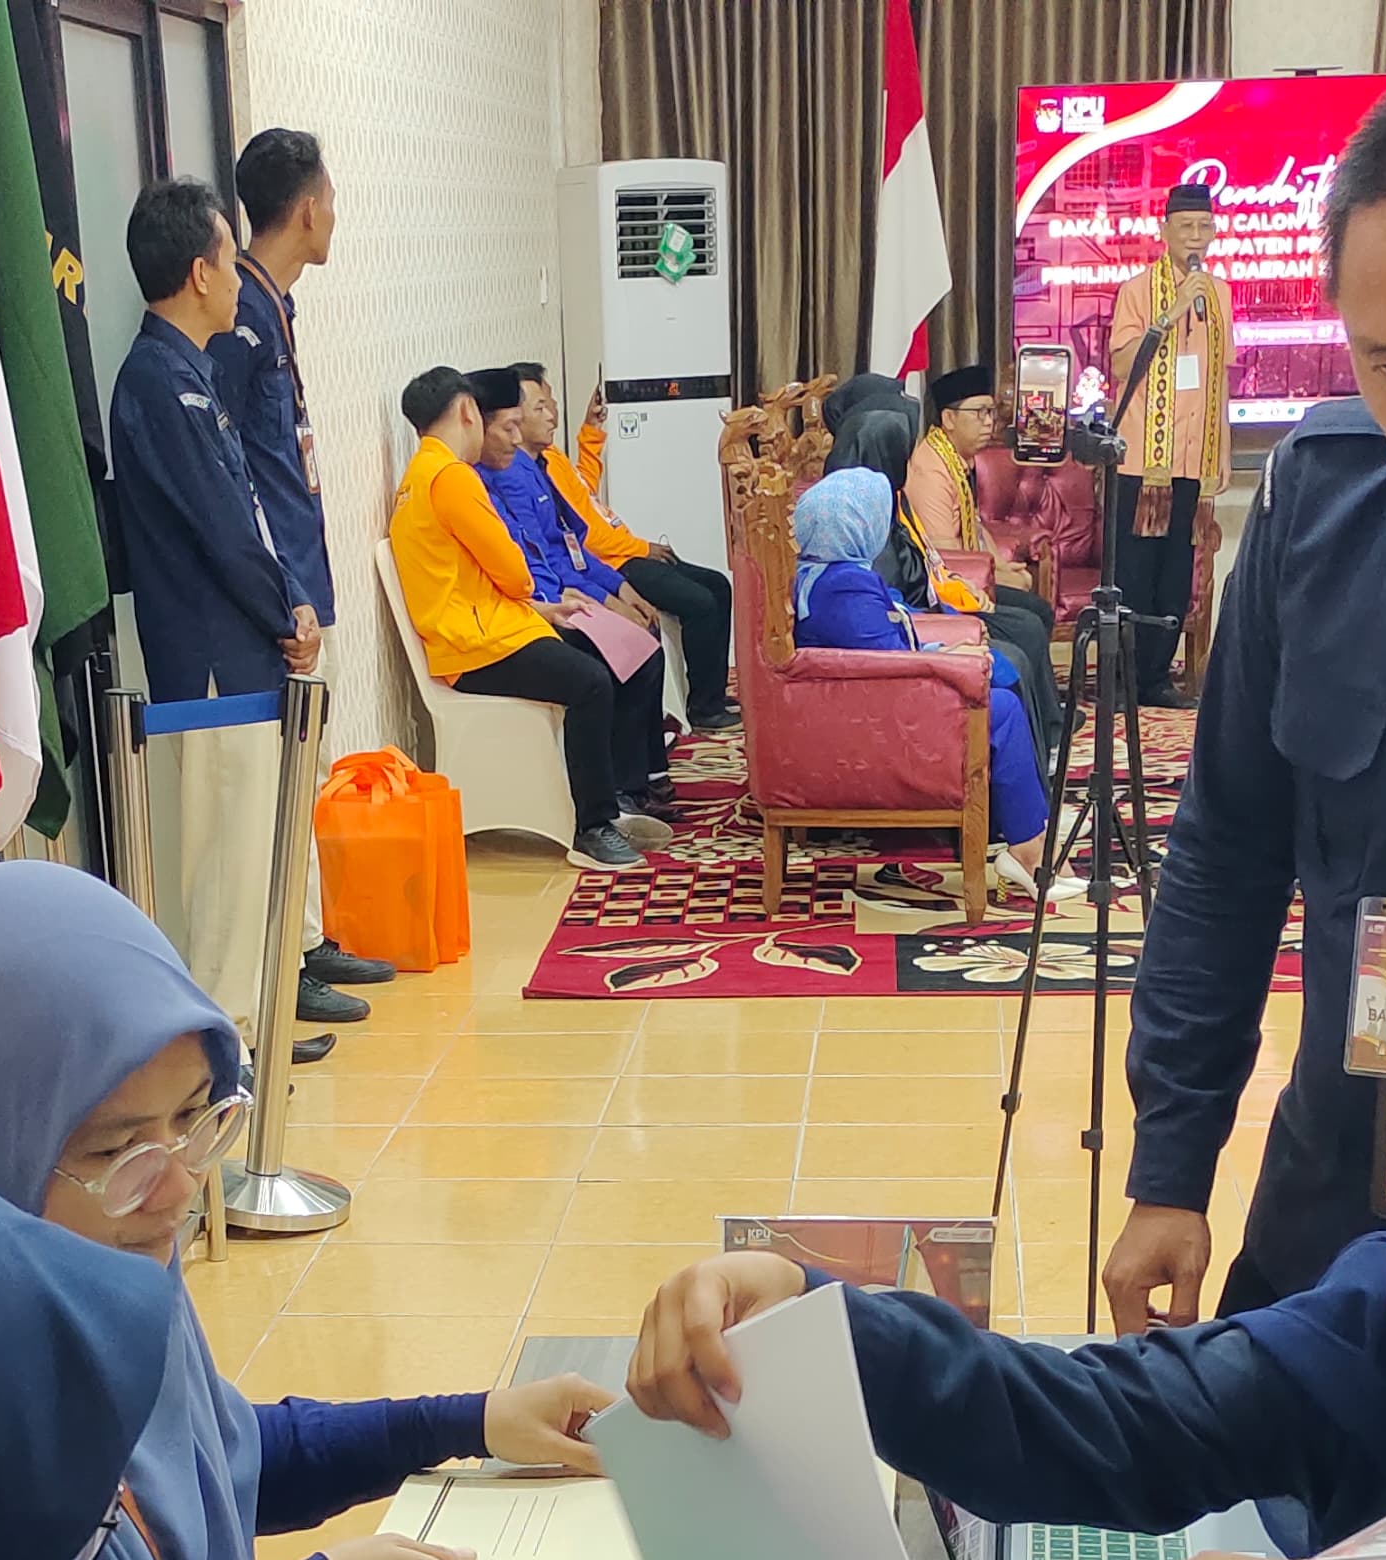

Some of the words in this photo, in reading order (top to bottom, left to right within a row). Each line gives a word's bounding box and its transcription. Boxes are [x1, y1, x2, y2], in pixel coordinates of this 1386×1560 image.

[1062, 95, 1105, 120] KPU
[1048, 217, 1116, 239] BAKAL
[1230, 259, 1313, 280] DAERAH
[747, 1227, 771, 1241] KPU
